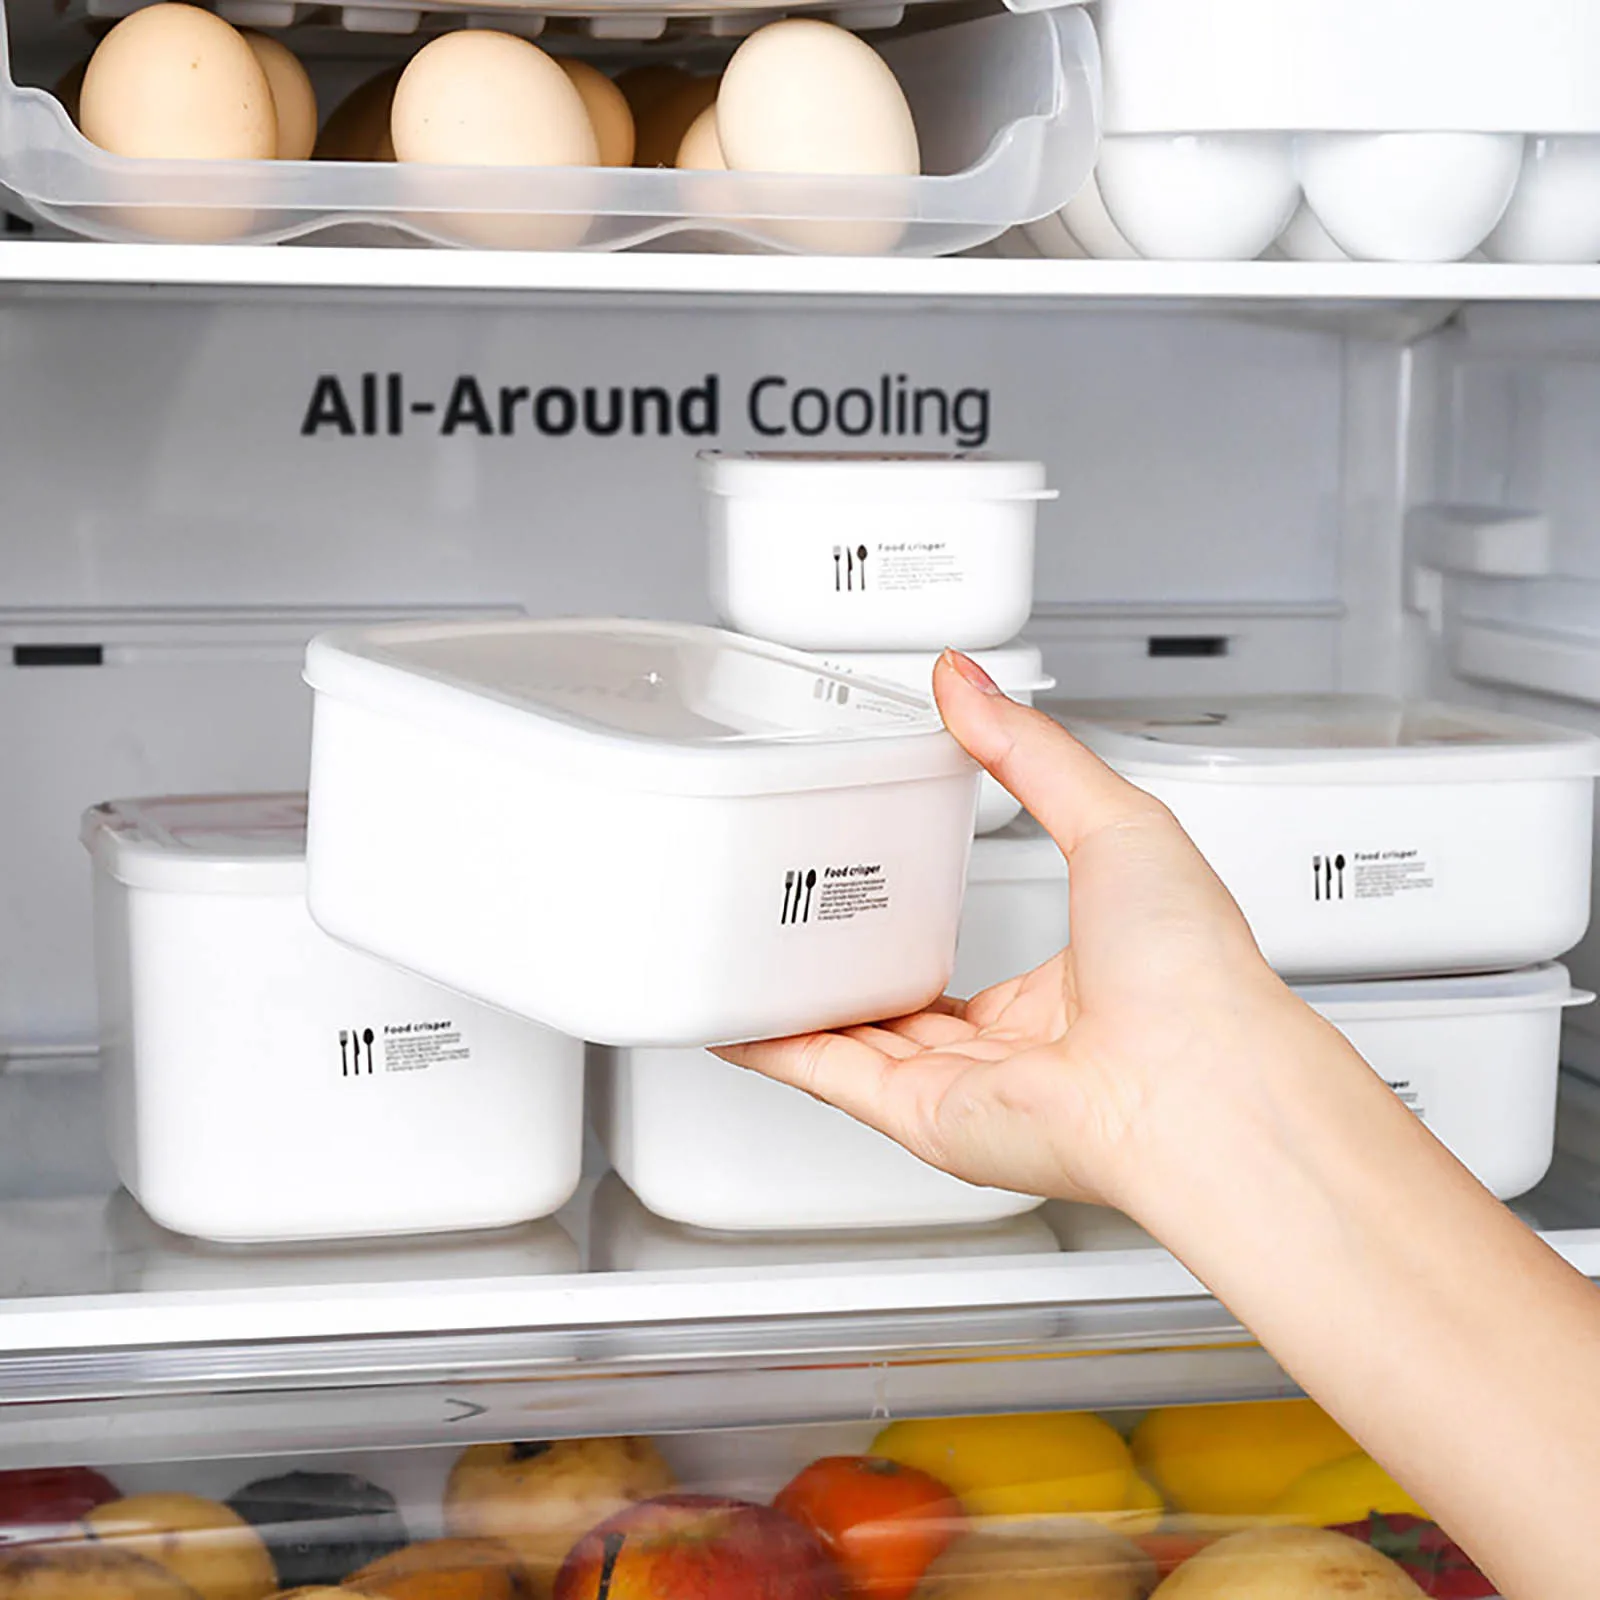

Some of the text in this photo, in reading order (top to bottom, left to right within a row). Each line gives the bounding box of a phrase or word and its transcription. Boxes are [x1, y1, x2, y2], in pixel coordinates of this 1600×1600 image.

[301, 374, 992, 447] All-Around Cooling
[824, 866, 848, 878] Food
[384, 1024, 411, 1034] Food
